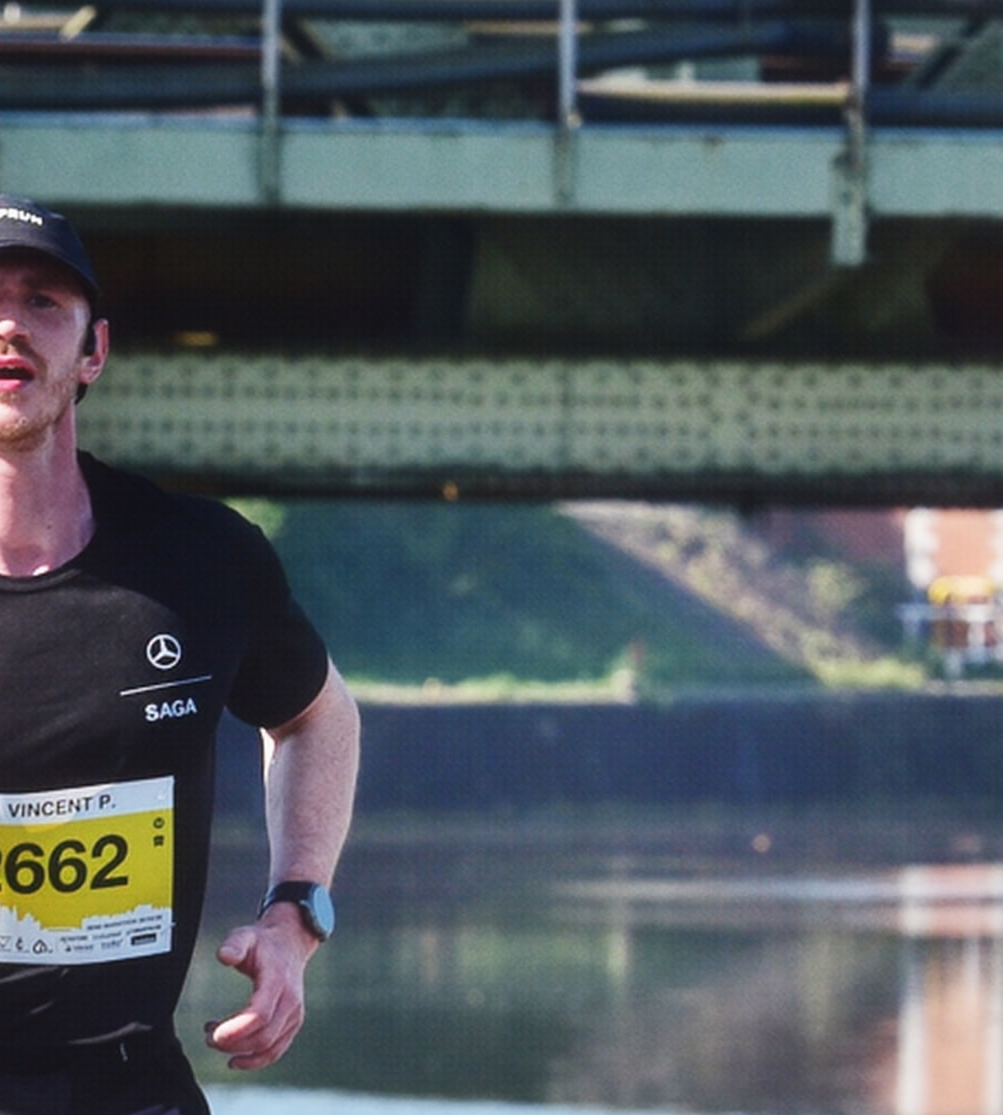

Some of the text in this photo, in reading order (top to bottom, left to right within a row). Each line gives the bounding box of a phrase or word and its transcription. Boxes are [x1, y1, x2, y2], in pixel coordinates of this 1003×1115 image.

[145, 698, 197, 721] SAGA
[8, 794, 116, 818] VINCENT P.
